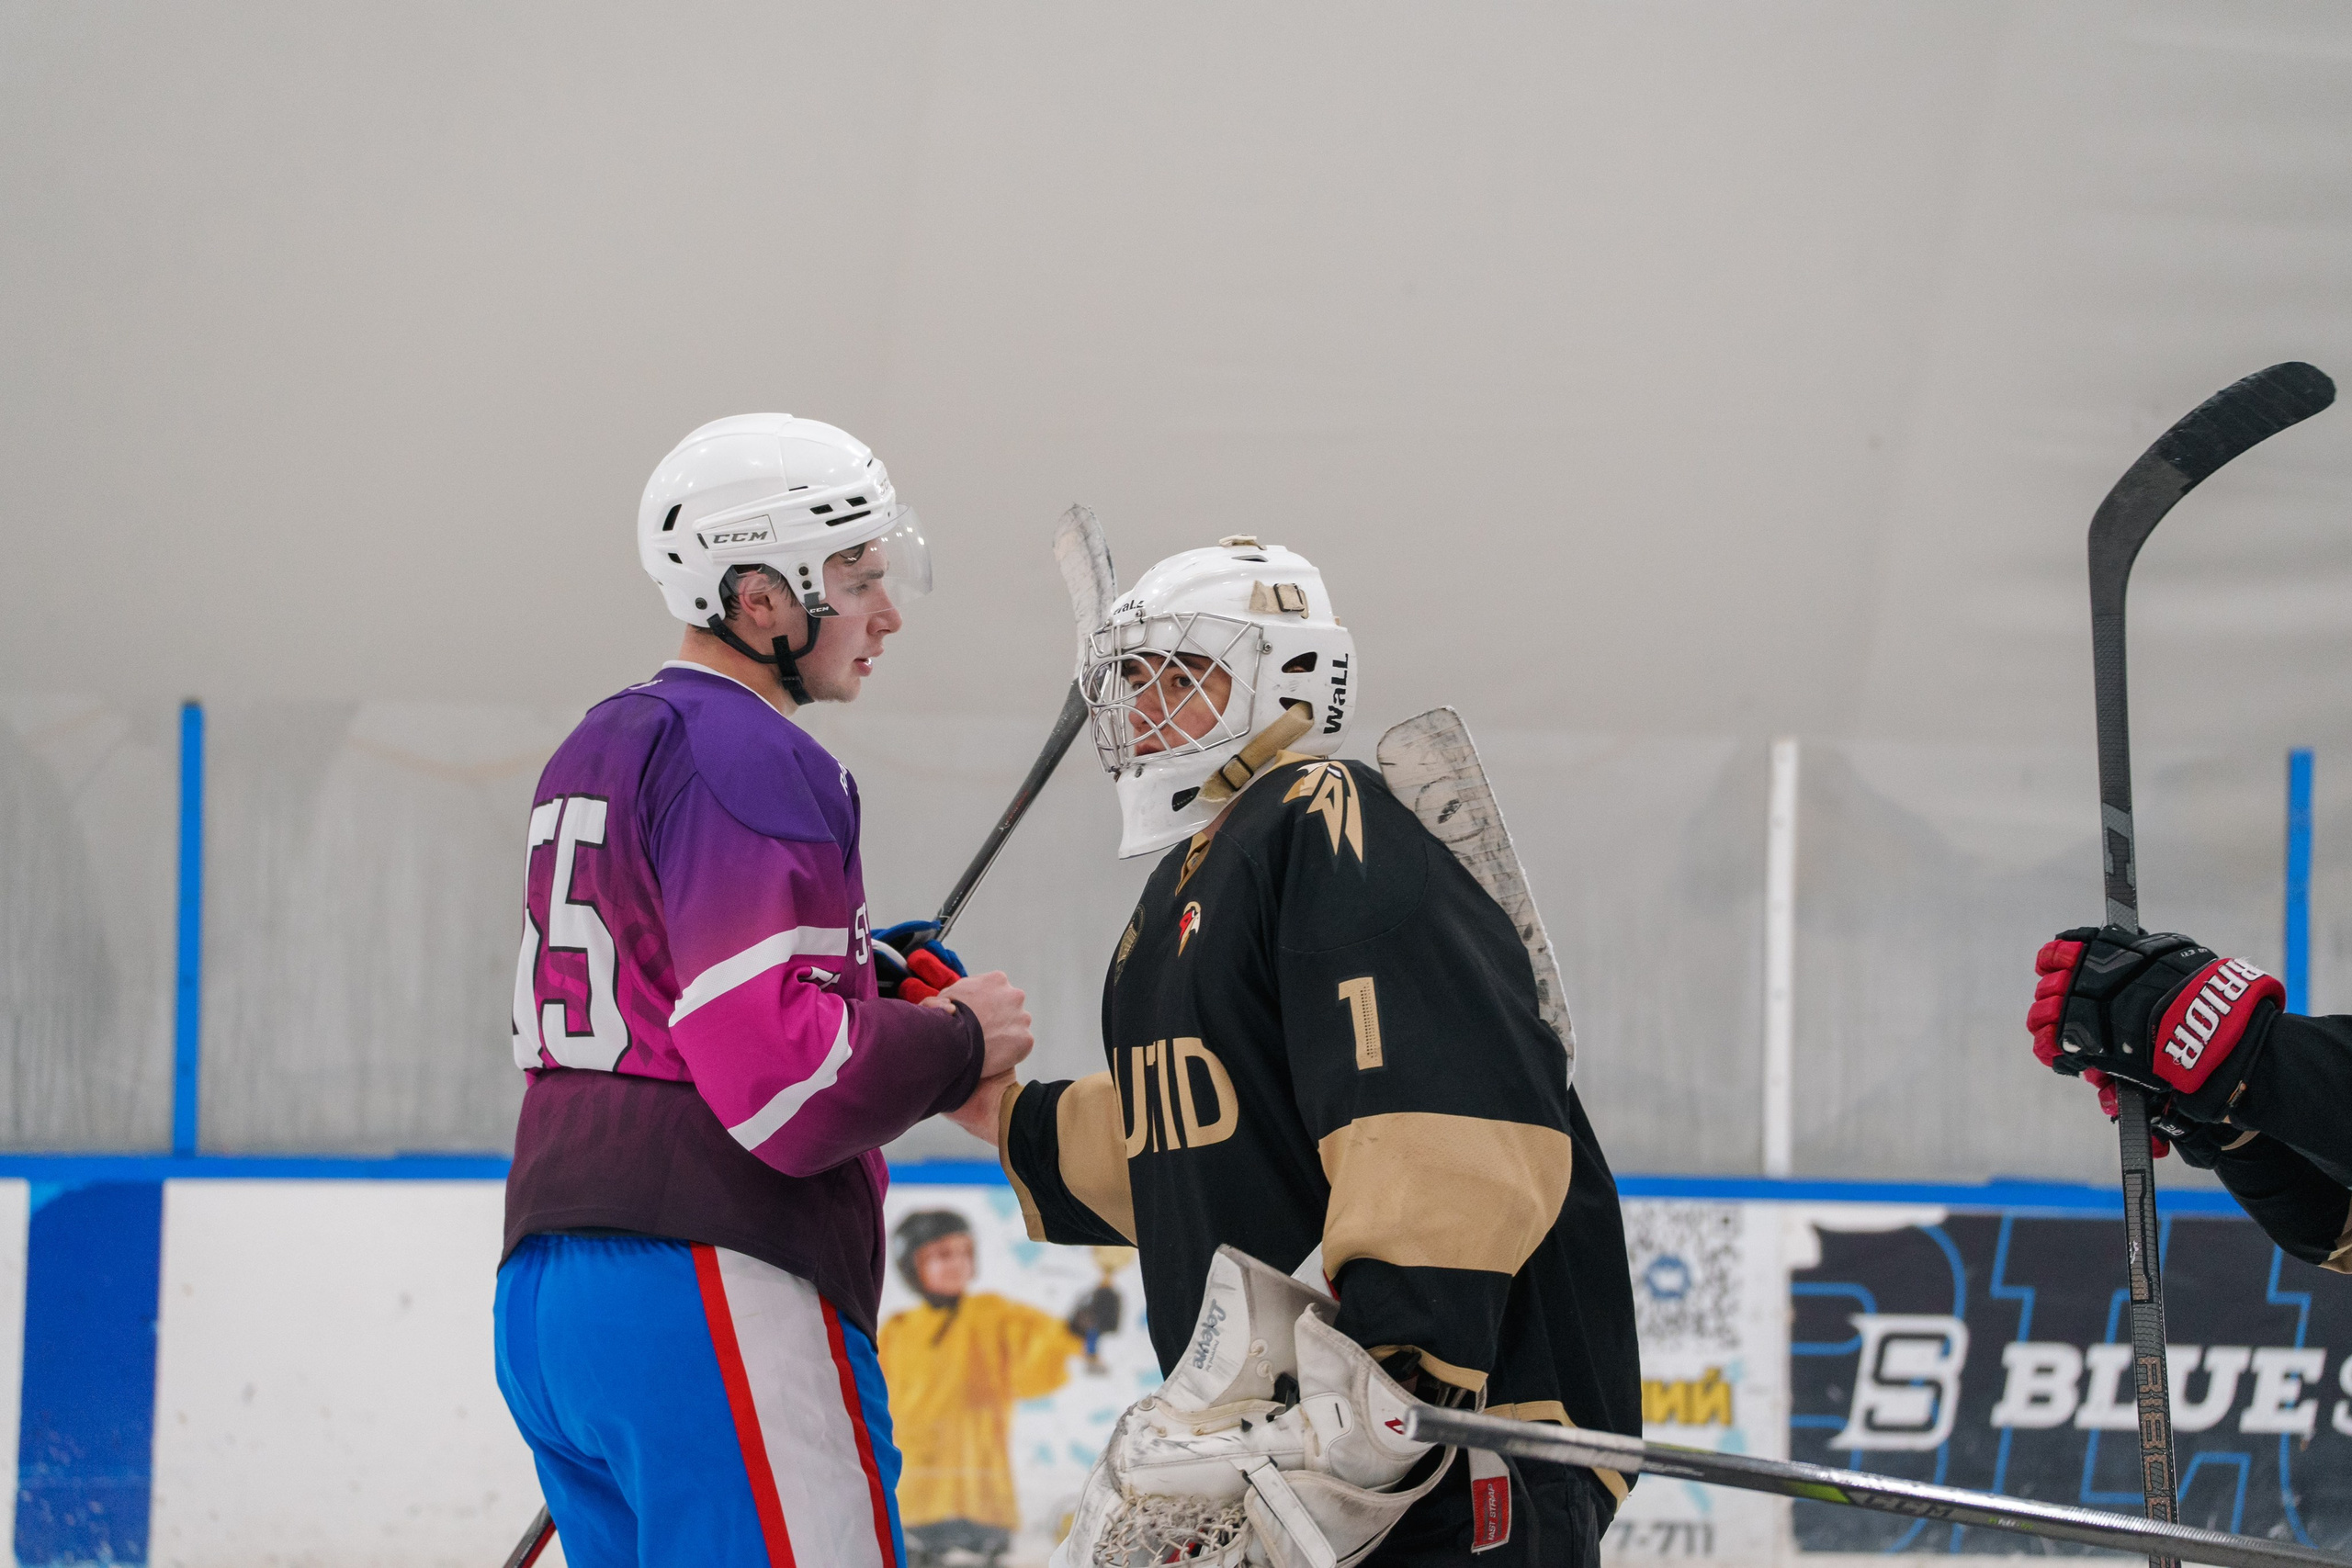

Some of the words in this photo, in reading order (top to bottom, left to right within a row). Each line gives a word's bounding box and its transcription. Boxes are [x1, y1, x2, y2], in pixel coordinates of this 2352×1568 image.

[713, 531, 768, 544] CCM
[1339, 976, 1384, 1071] 1
[1487, 1483, 1498, 1517] STRAP
